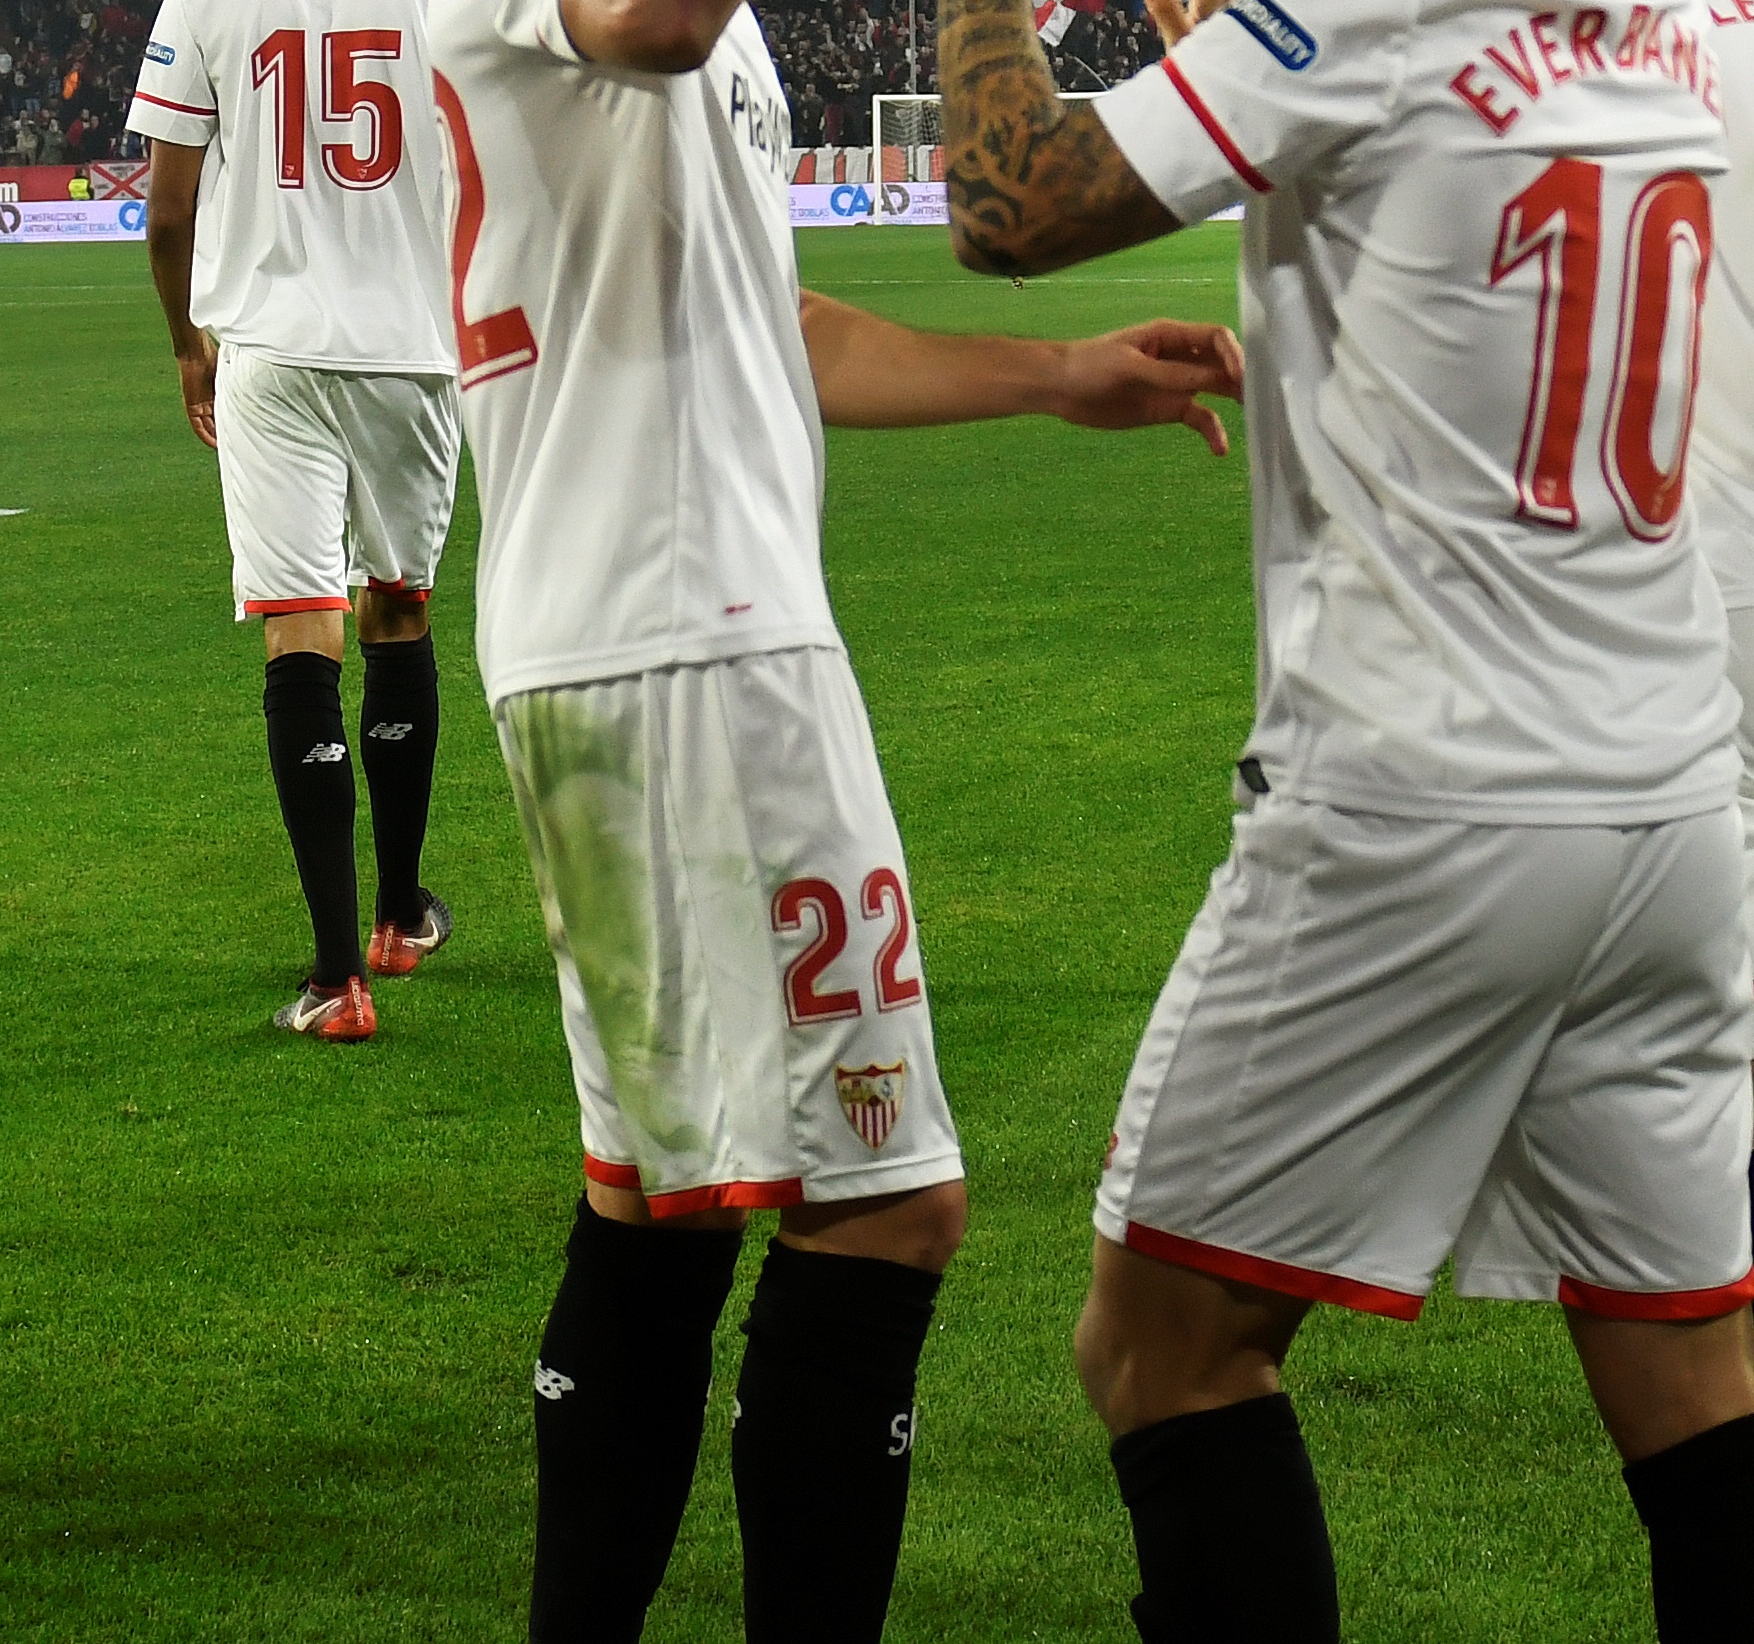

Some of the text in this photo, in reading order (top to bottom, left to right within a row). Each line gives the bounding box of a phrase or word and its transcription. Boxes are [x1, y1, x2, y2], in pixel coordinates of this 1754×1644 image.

[252, 28, 403, 190] 15
[1448, 7, 1609, 137] EVER
[1490, 156, 1715, 543] 10
[772, 867, 921, 1026] 22
